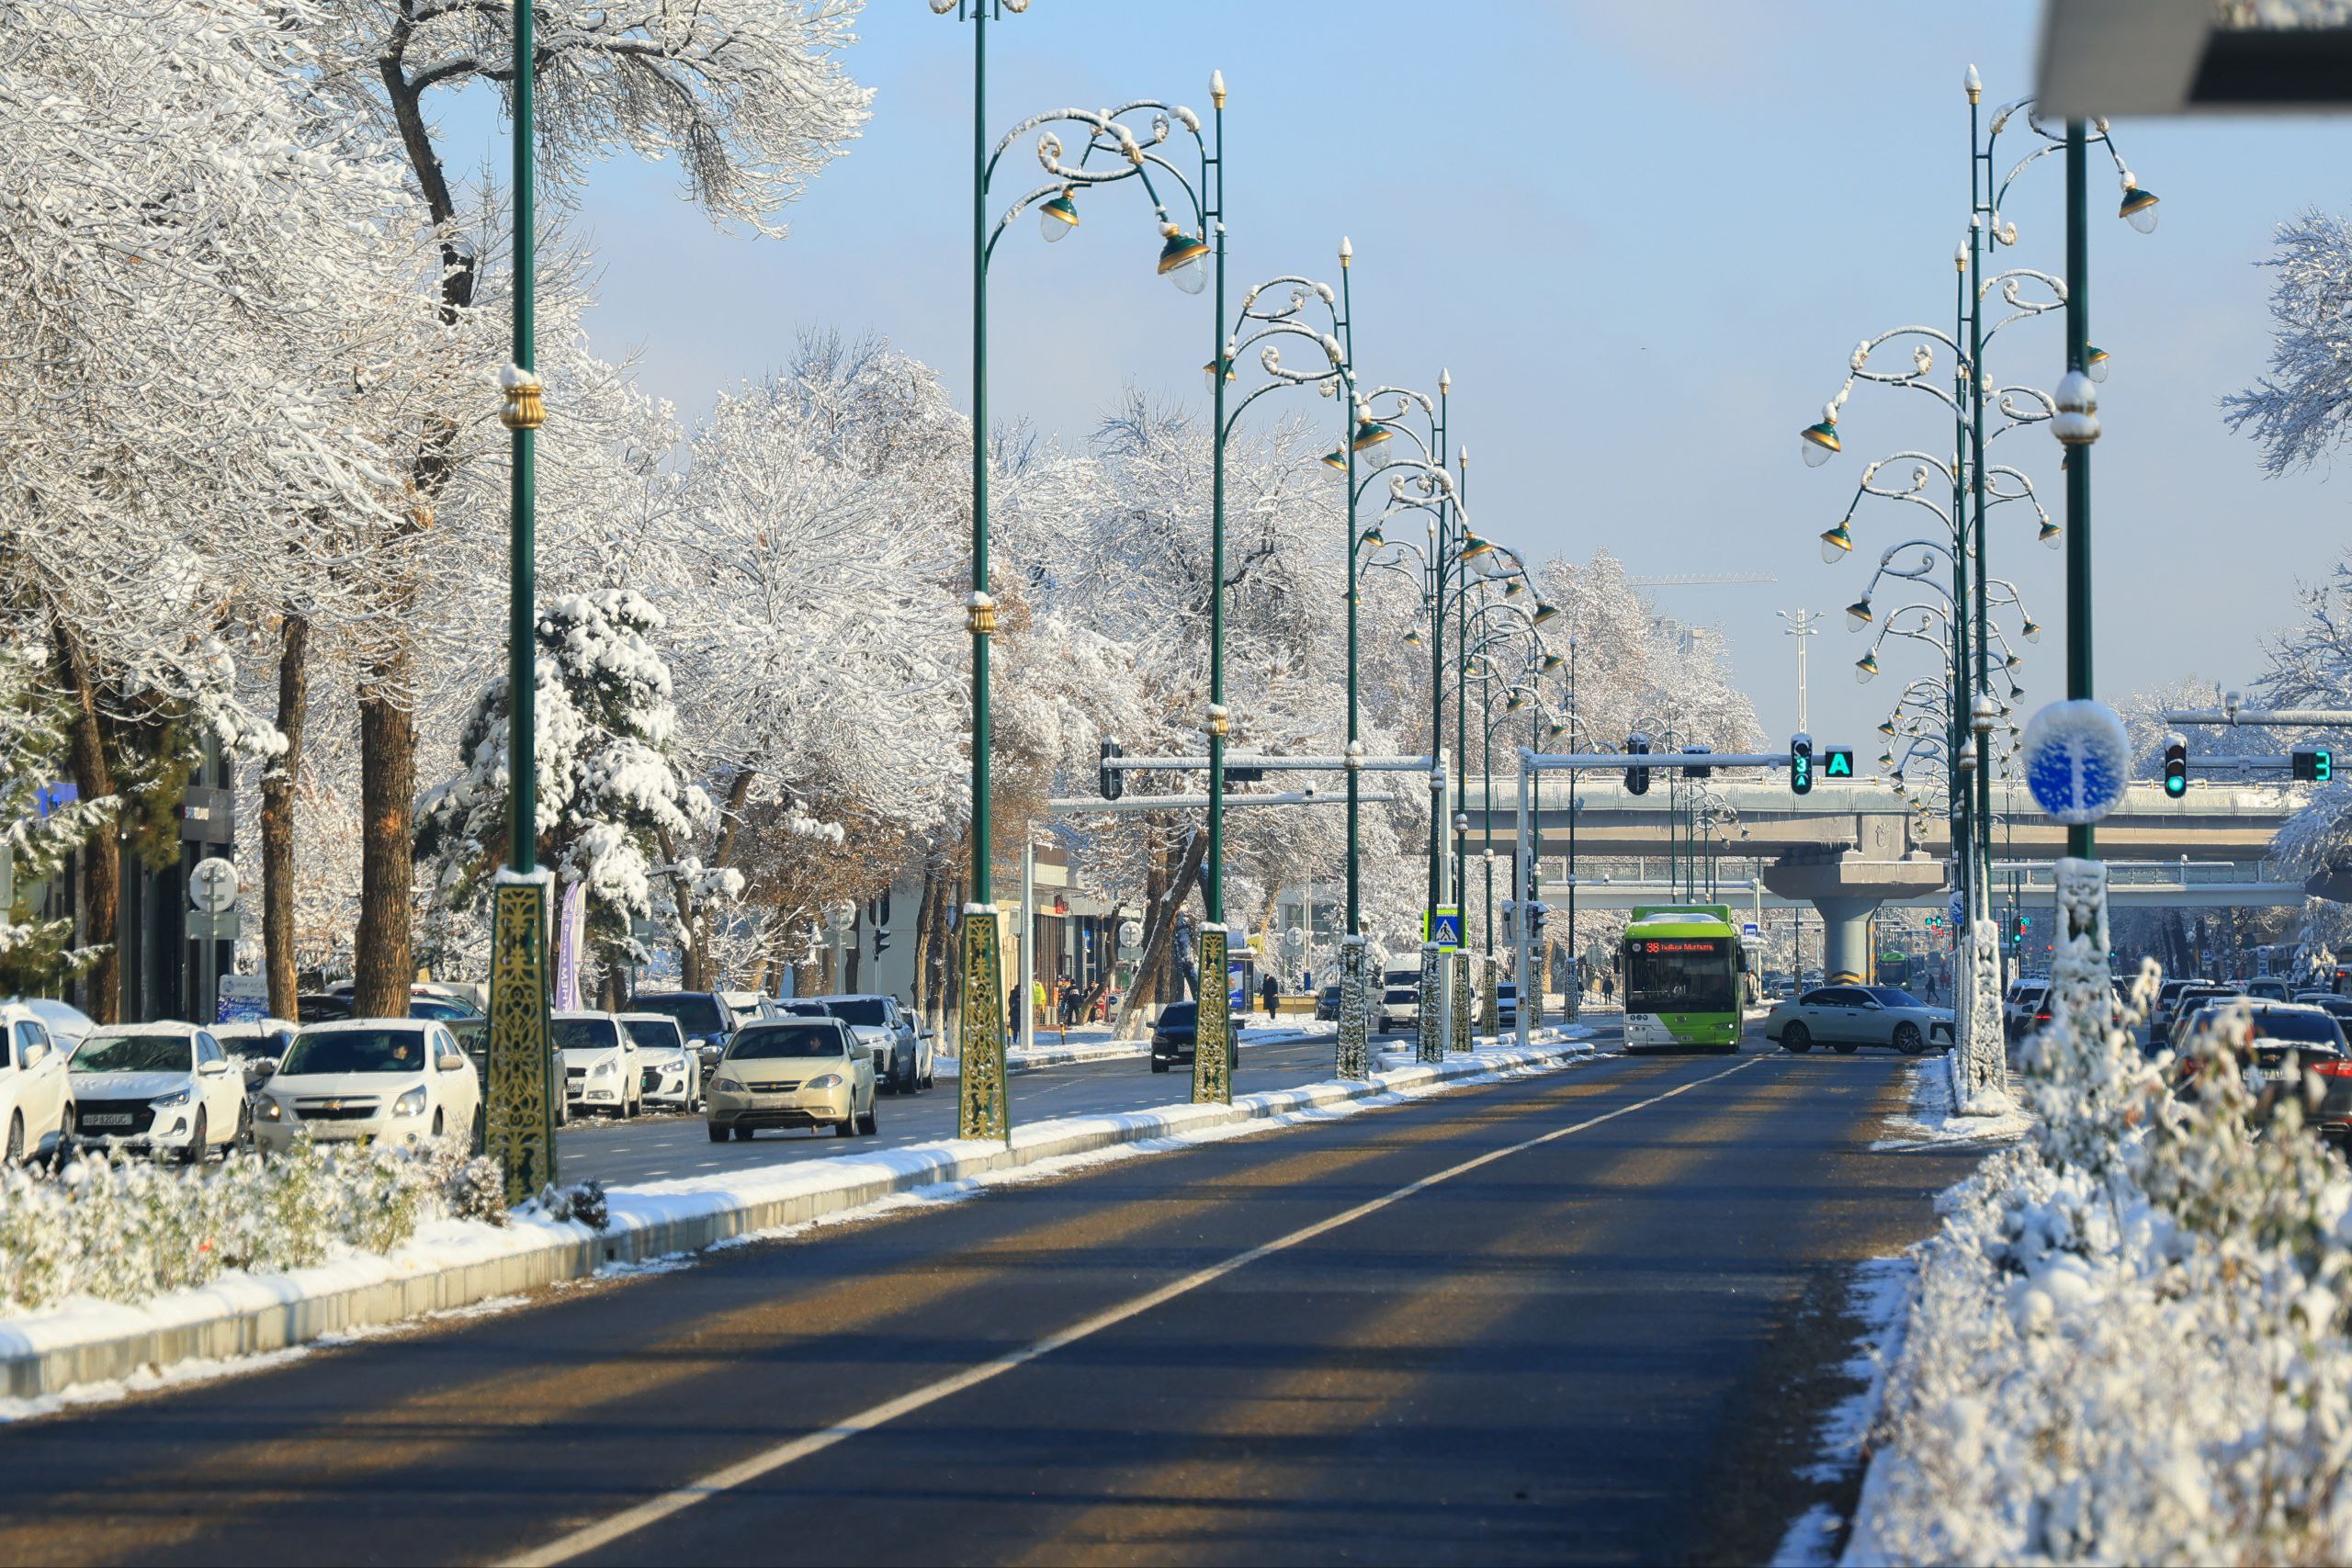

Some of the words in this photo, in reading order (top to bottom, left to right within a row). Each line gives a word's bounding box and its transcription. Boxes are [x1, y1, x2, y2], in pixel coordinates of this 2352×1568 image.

[1796, 757, 1807, 773] 3
[1828, 753, 1850, 774] A
[2315, 751, 2330, 781] 3
[1797, 775, 1806, 785] A
[1646, 942, 1659, 953] 38
